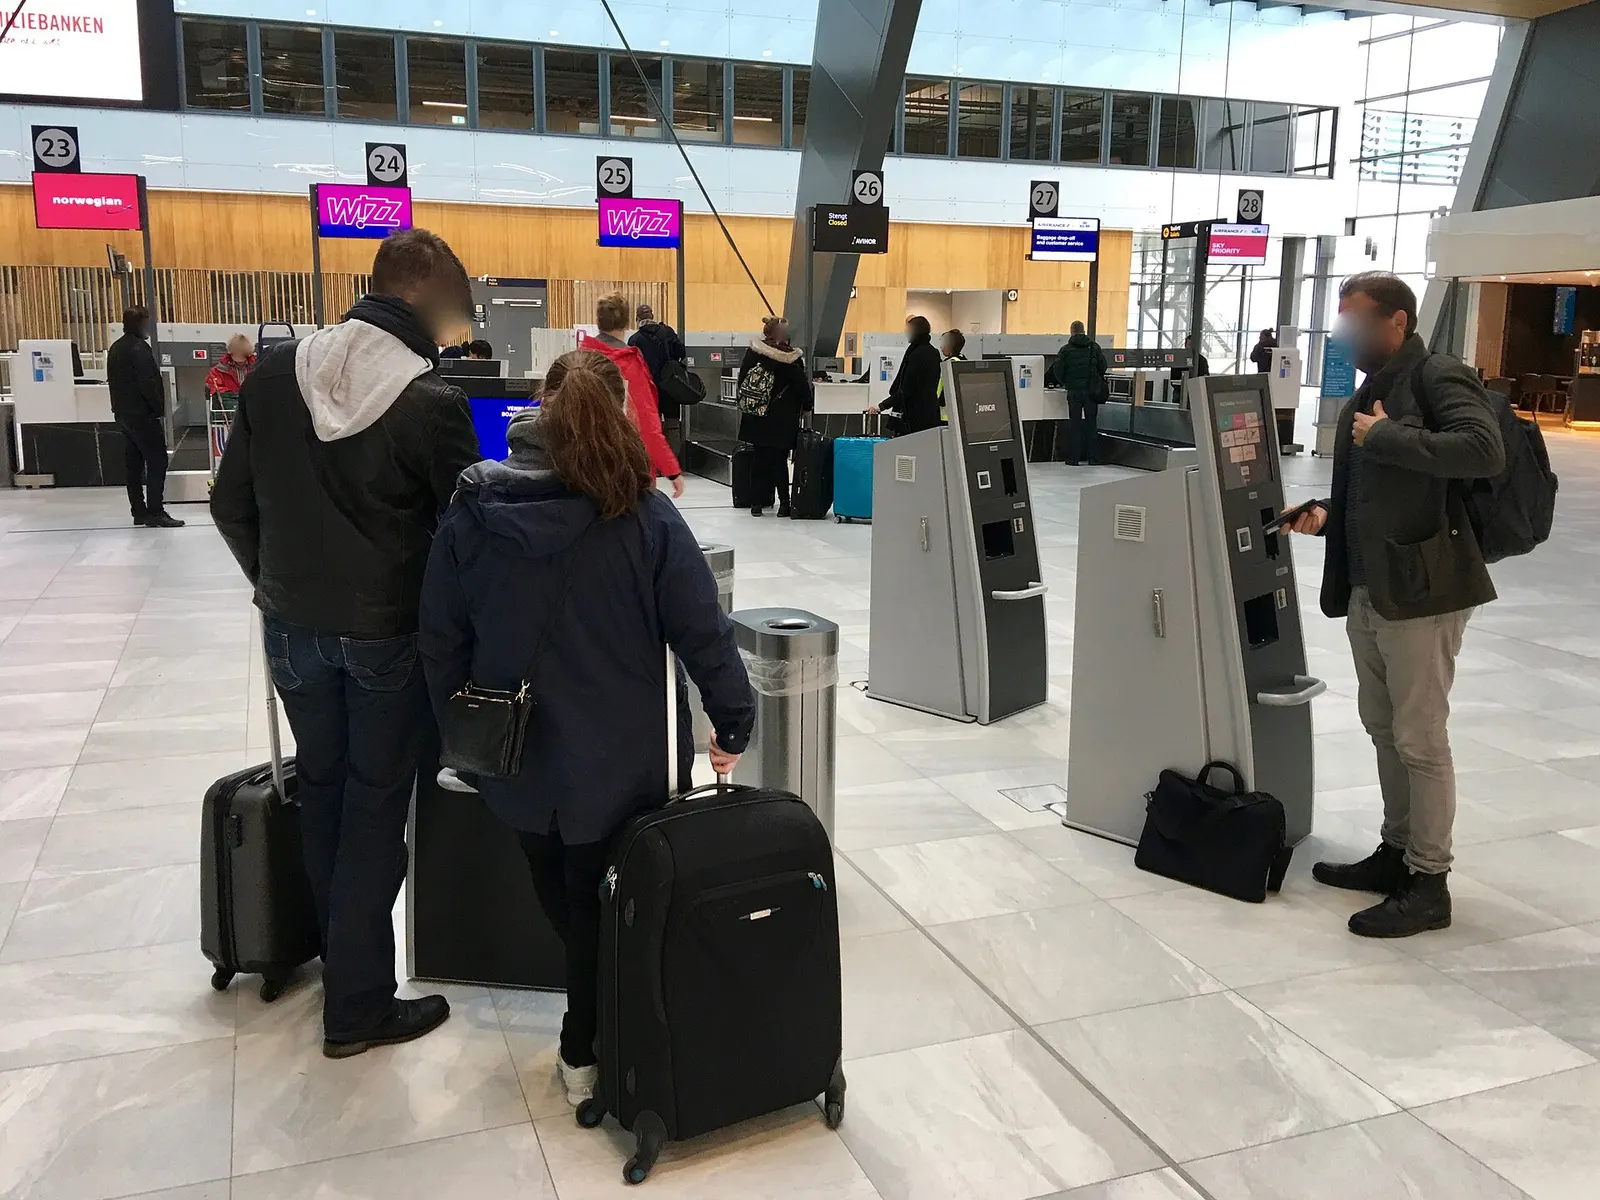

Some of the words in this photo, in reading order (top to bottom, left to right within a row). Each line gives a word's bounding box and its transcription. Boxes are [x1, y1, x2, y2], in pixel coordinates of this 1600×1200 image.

[41, 138, 71, 157] 23
[374, 154, 400, 173] 24
[603, 167, 626, 185] 25
[858, 180, 878, 196] 26
[52, 196, 122, 207] norwegian
[1035, 190, 1054, 206] 27
[1242, 198, 1259, 213] 28
[828, 212, 848, 220] Stengt
[978, 403, 996, 412] AVINOR
